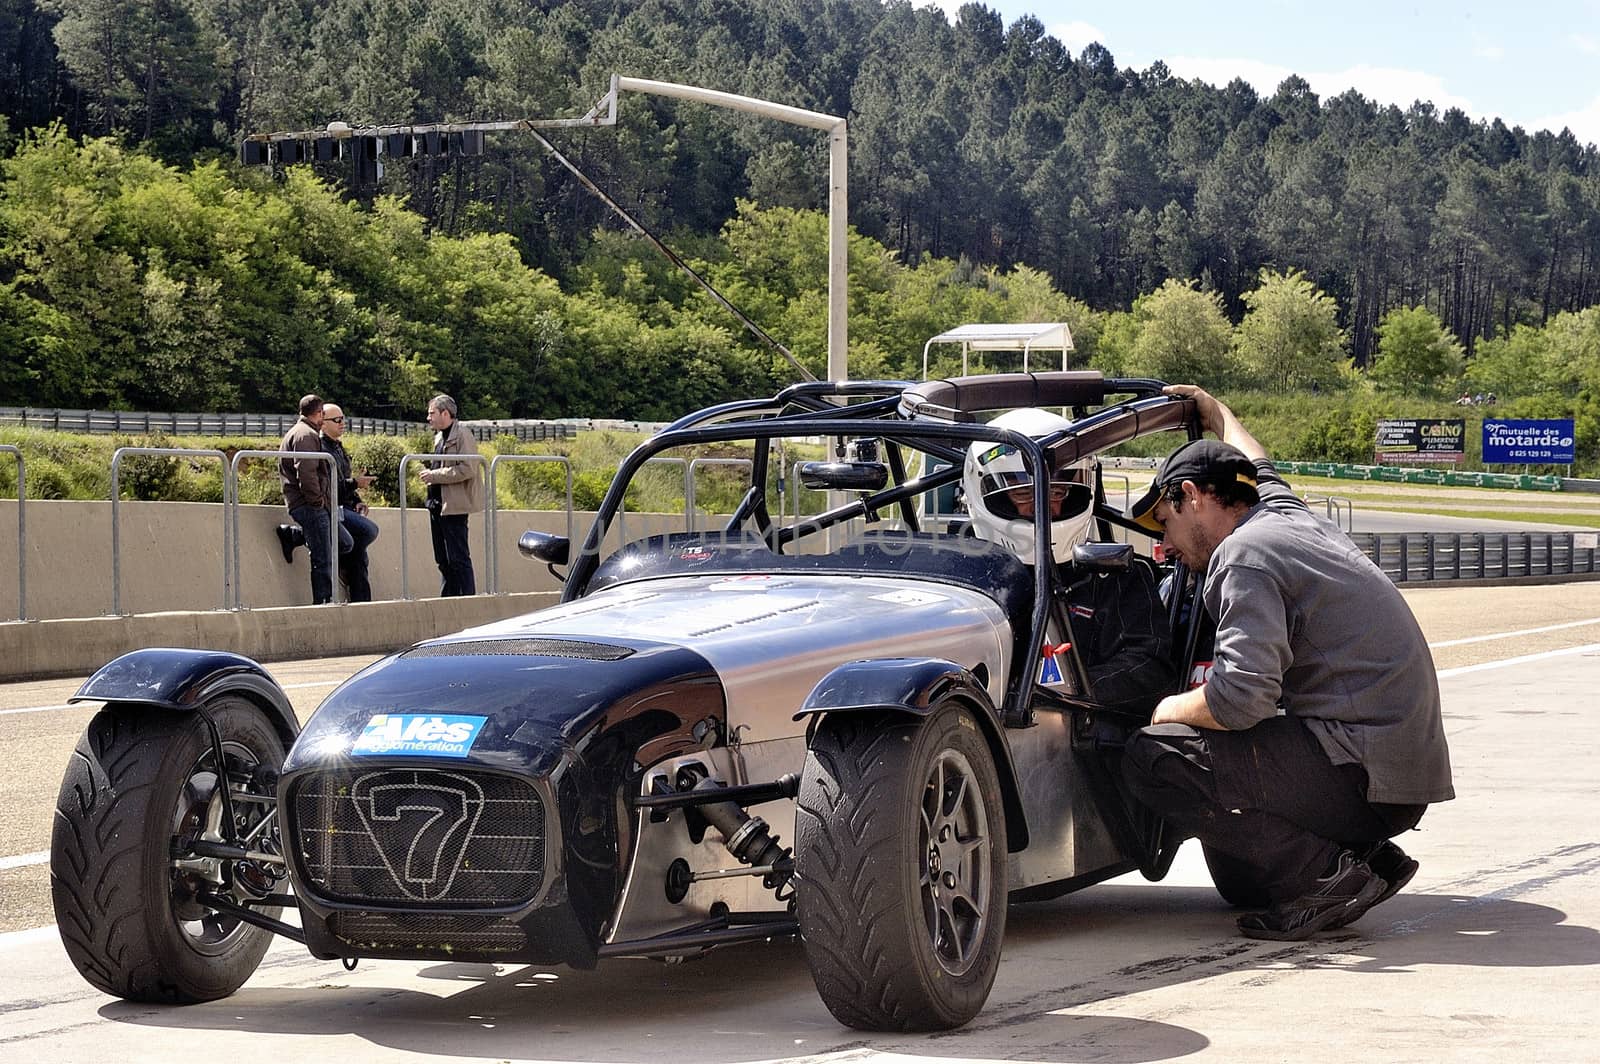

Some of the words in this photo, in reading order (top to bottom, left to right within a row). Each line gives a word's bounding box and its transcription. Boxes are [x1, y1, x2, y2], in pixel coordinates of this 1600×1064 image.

[1420, 425, 1462, 437] CASINO
[1499, 427, 1541, 436] mutuelle
[1543, 427, 1560, 436] des
[1488, 435, 1560, 446] motards
[364, 716, 475, 743] Alès
[369, 783, 468, 883] 7
